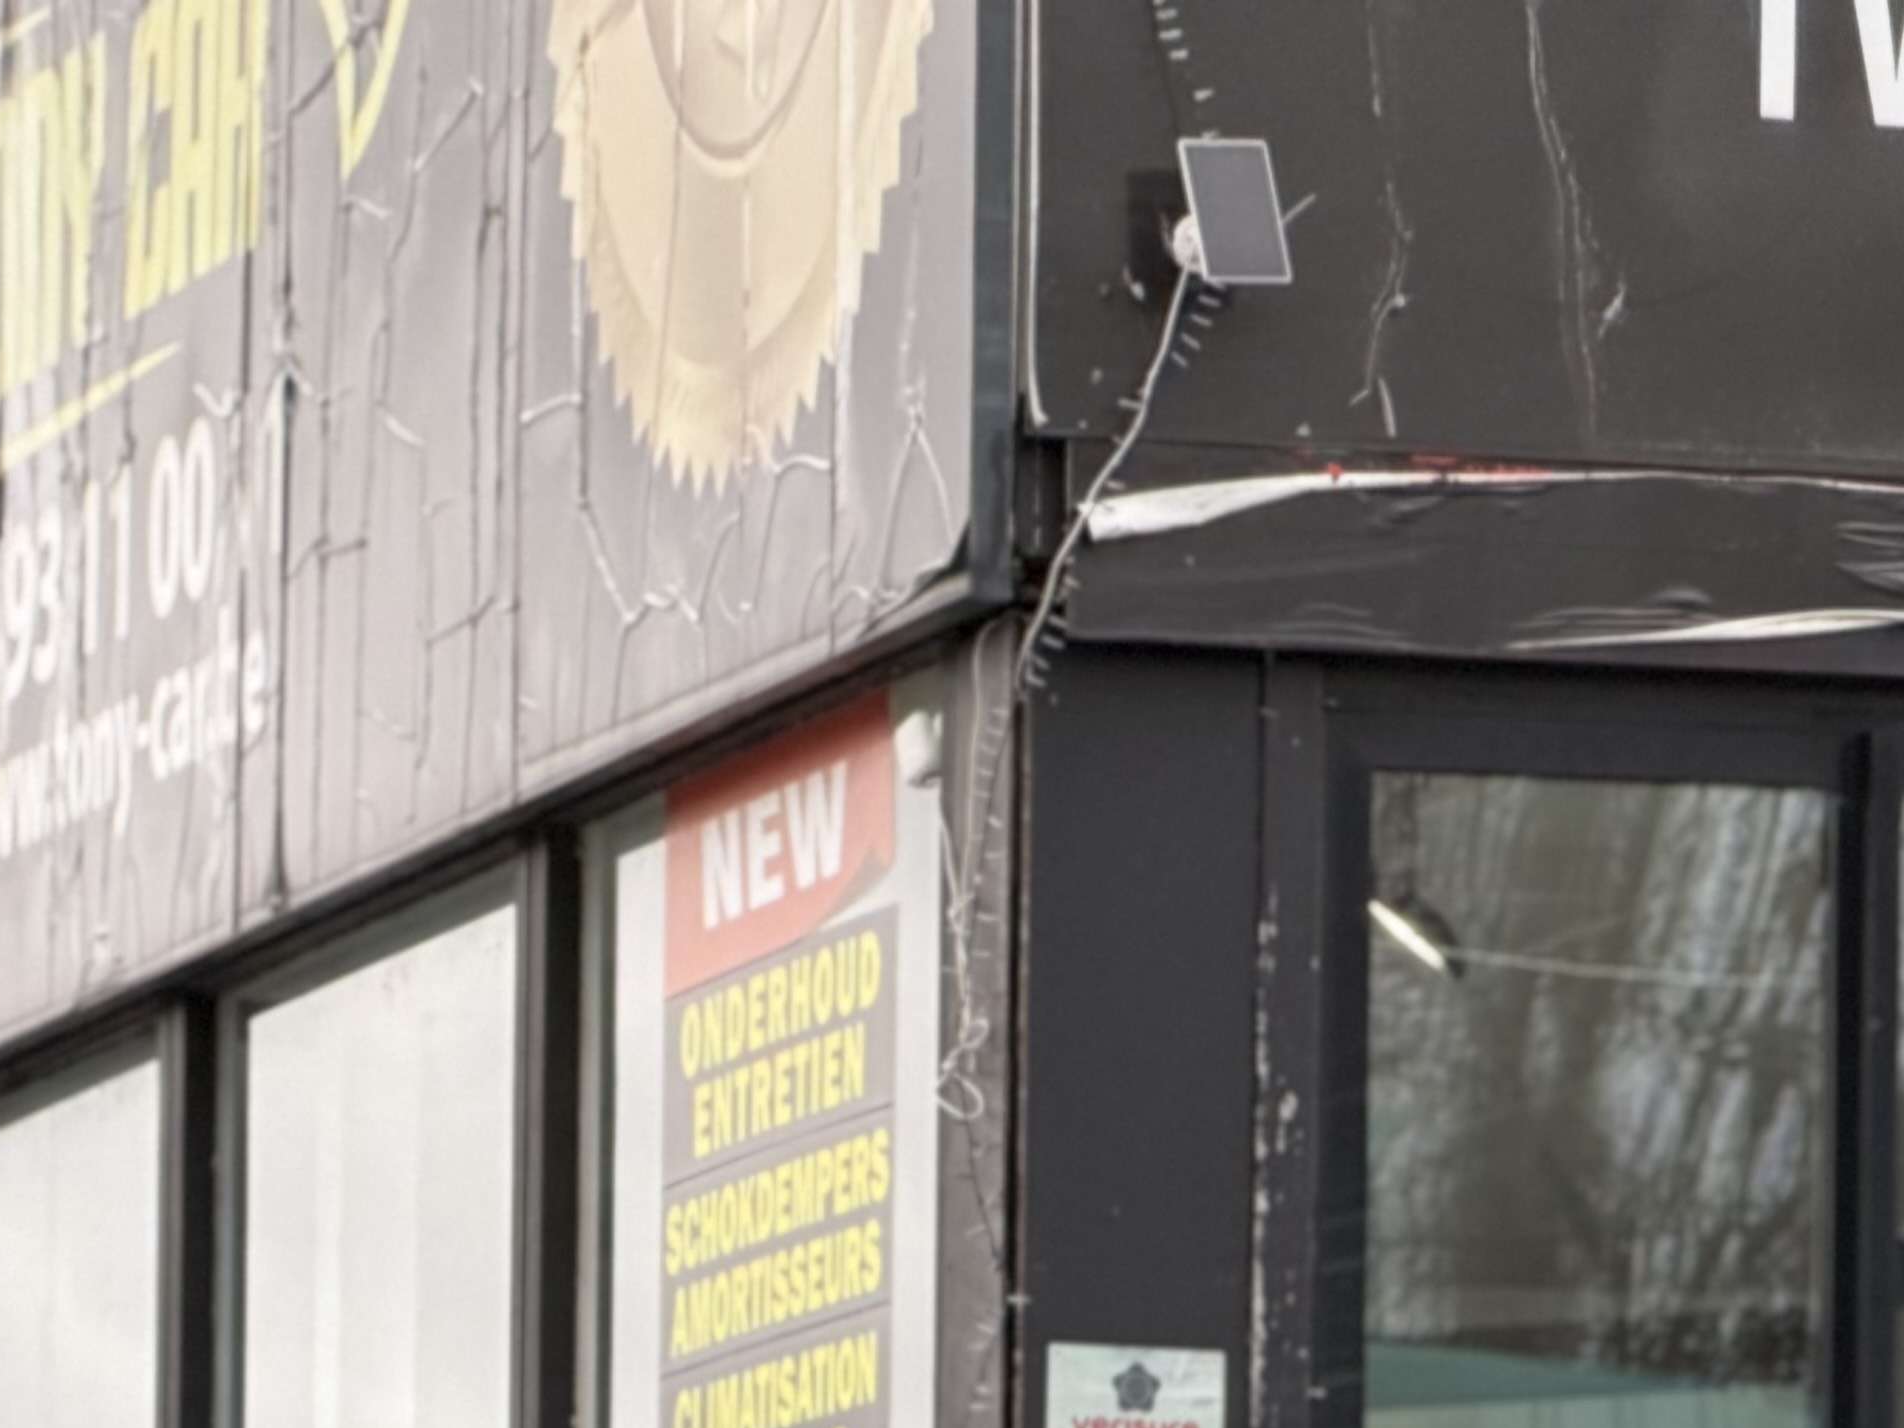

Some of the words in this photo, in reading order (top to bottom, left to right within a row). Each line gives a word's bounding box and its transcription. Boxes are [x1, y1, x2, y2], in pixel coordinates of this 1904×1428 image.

[700, 760, 848, 929] NEW
[679, 930, 882, 1078] ONDERHOUD
[693, 1022, 866, 1158] ENTRETIEN
[665, 1126, 890, 1276] SCHOKDEMPERS
[670, 1219, 882, 1358] AMORTISSEURS
